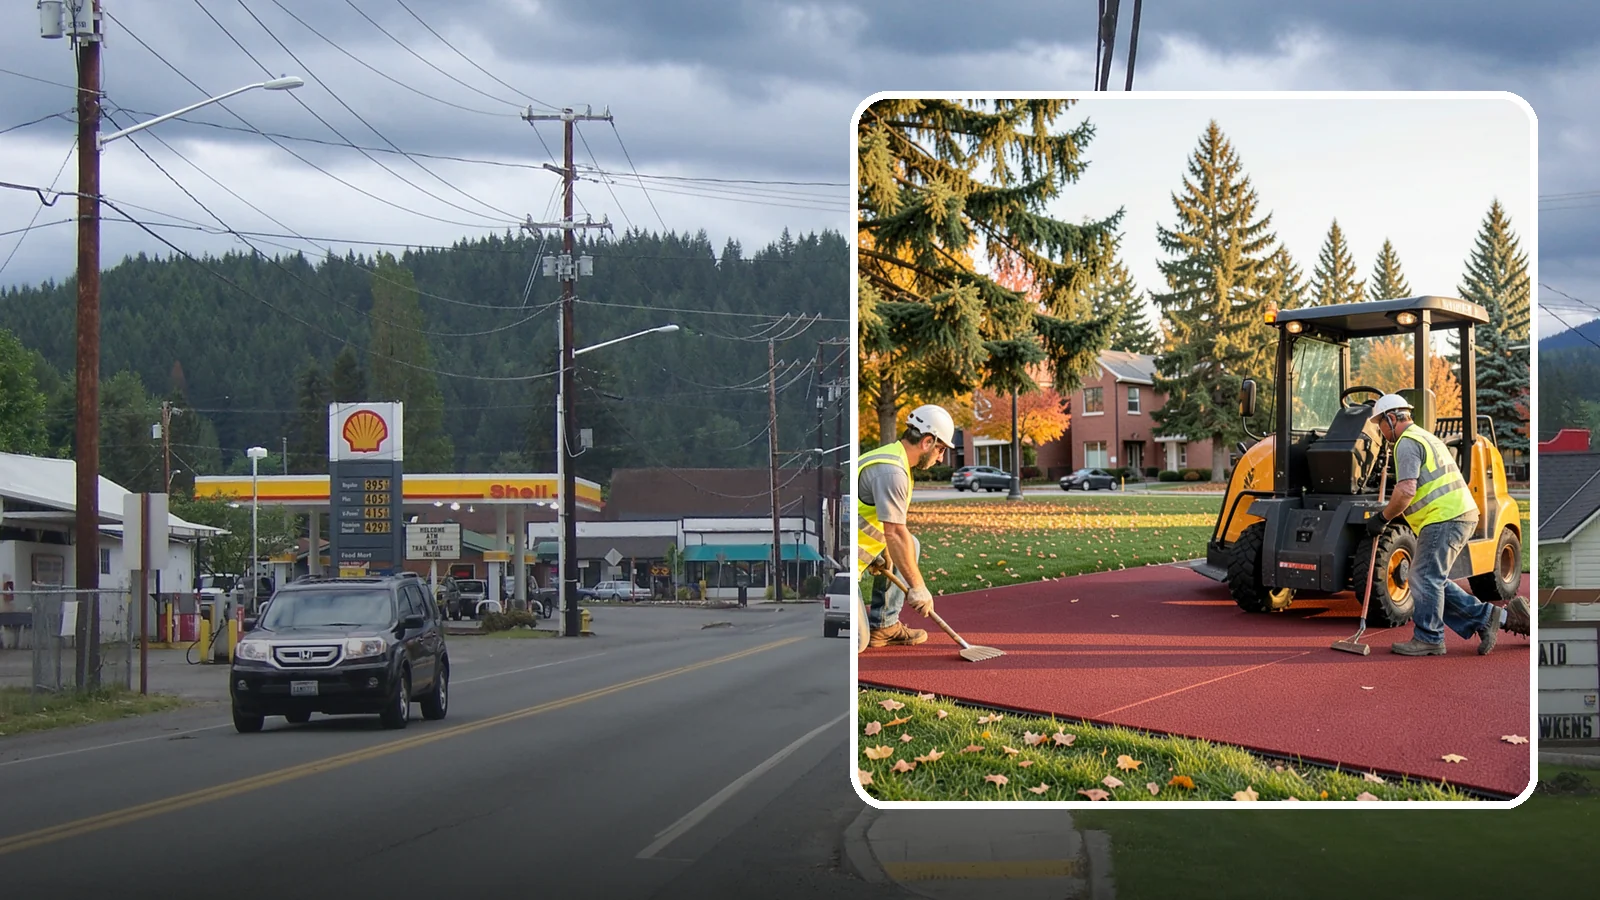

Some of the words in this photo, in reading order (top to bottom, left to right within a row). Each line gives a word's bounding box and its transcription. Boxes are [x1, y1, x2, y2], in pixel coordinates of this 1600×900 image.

[366, 480, 383, 490] 395
[490, 484, 547, 499] Shell
[366, 494, 383, 504] 405
[366, 508, 383, 518] 415
[366, 523, 383, 532] 429
[1539, 643, 1566, 665] AID
